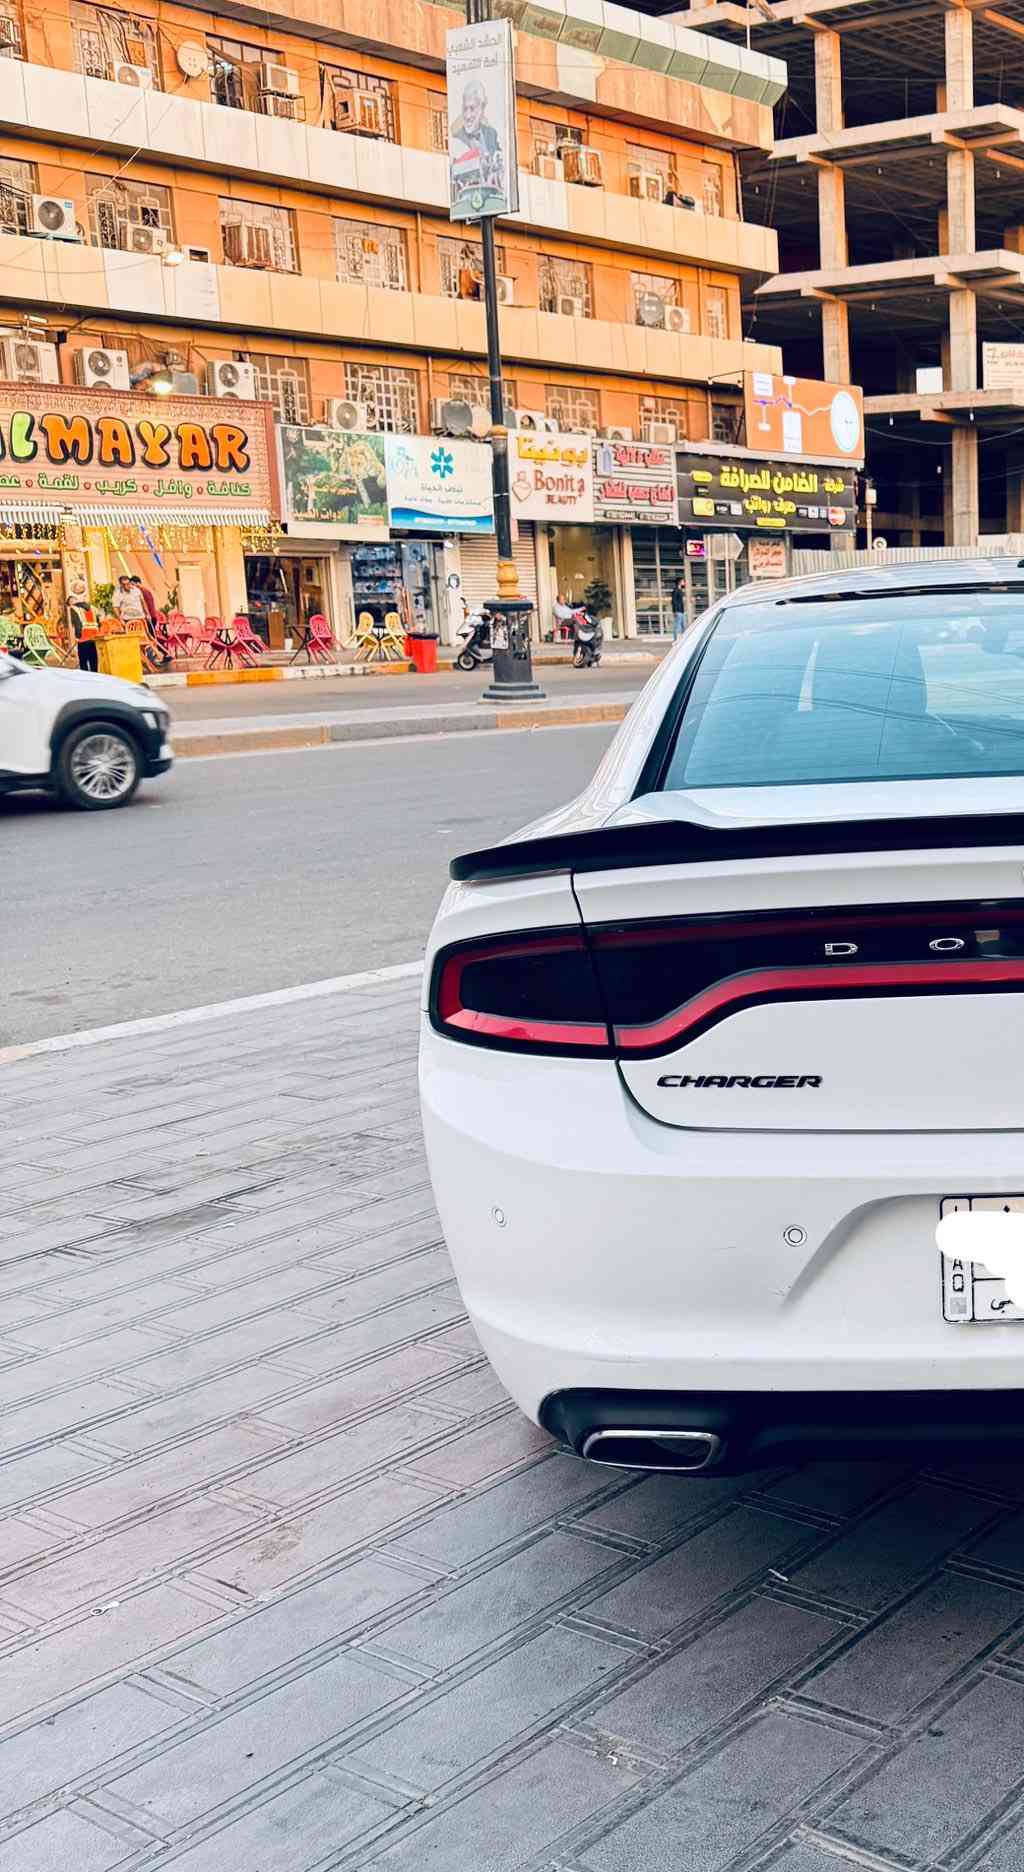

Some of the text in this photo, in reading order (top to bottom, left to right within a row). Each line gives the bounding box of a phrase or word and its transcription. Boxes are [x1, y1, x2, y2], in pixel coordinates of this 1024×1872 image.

[0, 411, 251, 473] LMAYAR
[38, 472, 80, 490] لقمة
[95, 479, 138, 496] كريب
[153, 478, 193, 499] وافل
[207, 480, 252, 497] كنافة
[533, 469, 585, 498] Bonita
[720, 465, 771, 493] للصرافة
[773, 471, 818, 495] الضامن
[656, 1074, 823, 1089] CHARGER
